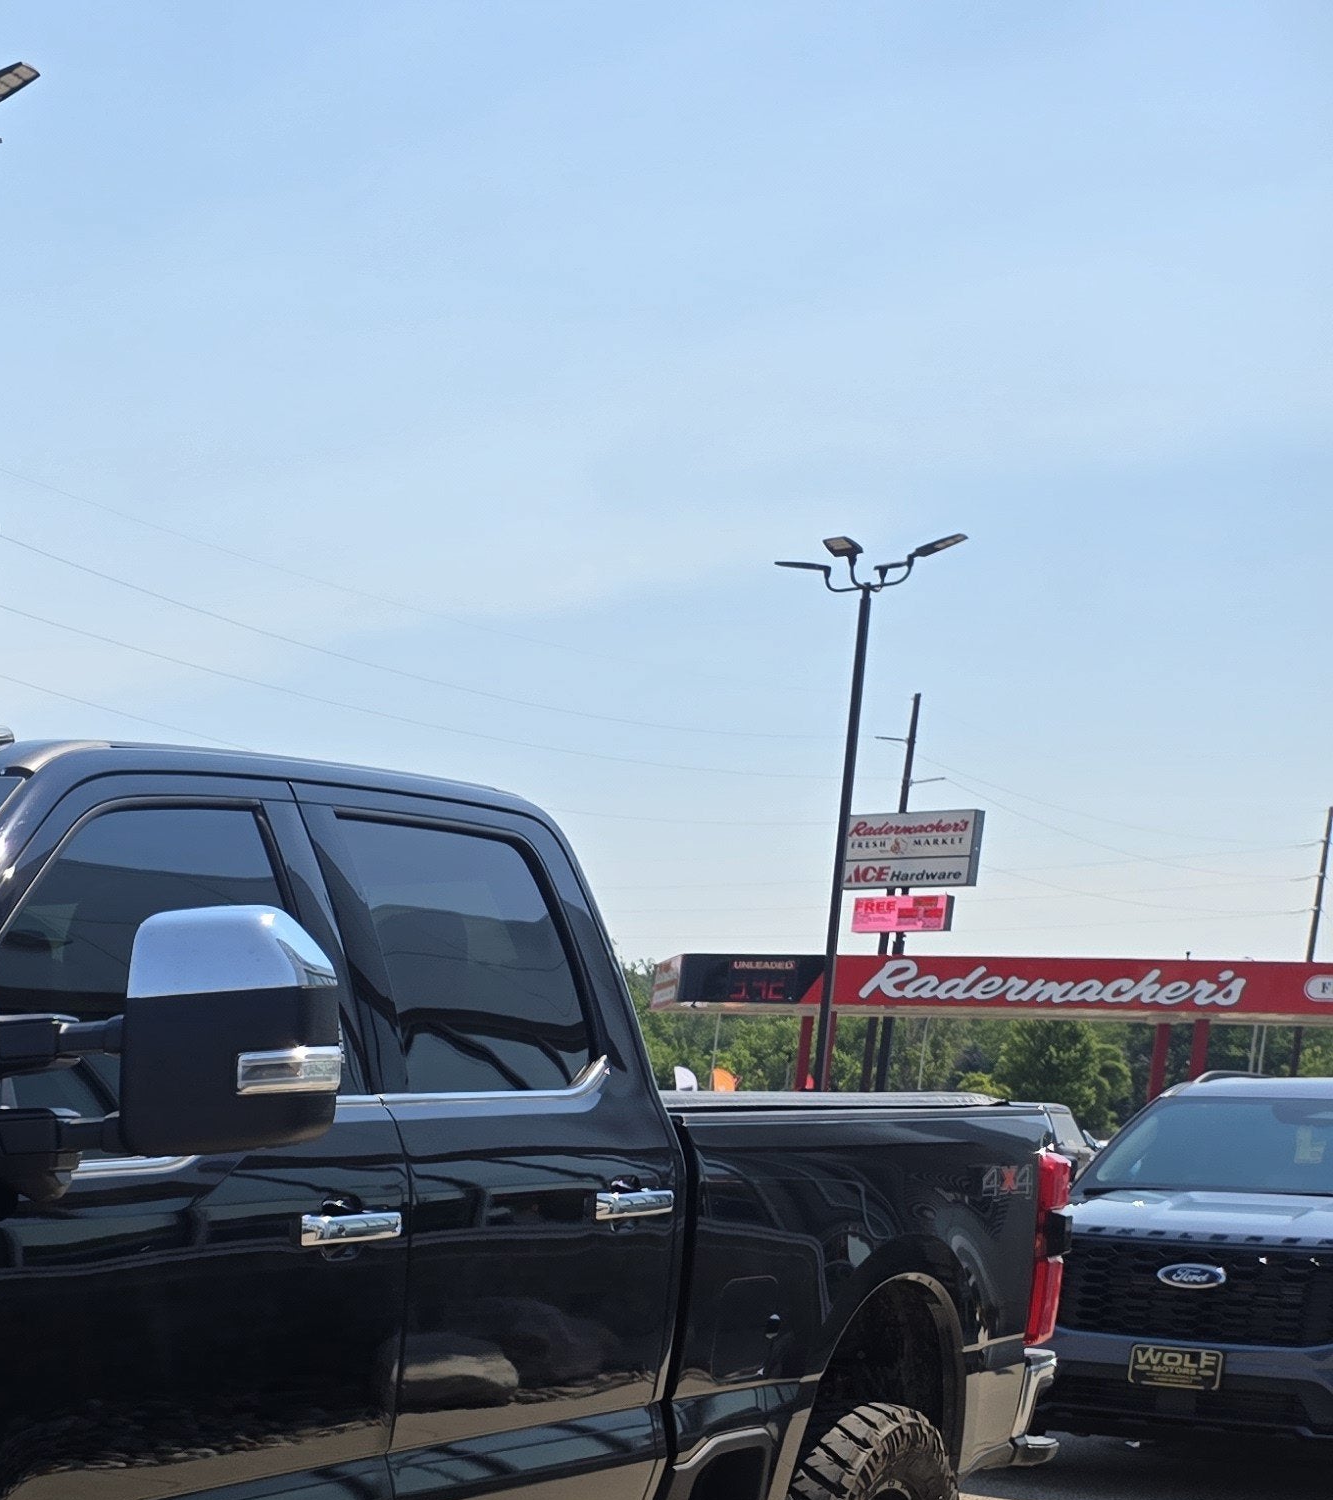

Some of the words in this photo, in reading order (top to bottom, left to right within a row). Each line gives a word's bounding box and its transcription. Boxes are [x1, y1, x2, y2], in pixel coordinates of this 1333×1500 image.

[849, 819, 970, 837] Radermacher's
[851, 840, 887, 849] FRESH
[913, 837, 964, 847] MARKET
[845, 864, 891, 883] ACE
[890, 869, 962, 882] Hardware
[854, 900, 896, 914] FREE
[734, 960, 794, 970] UNLEADED
[858, 959, 1247, 1006] Radermacher's
[1136, 1346, 1217, 1369] WOLF
[1152, 1365, 1197, 1375] MOTORS
